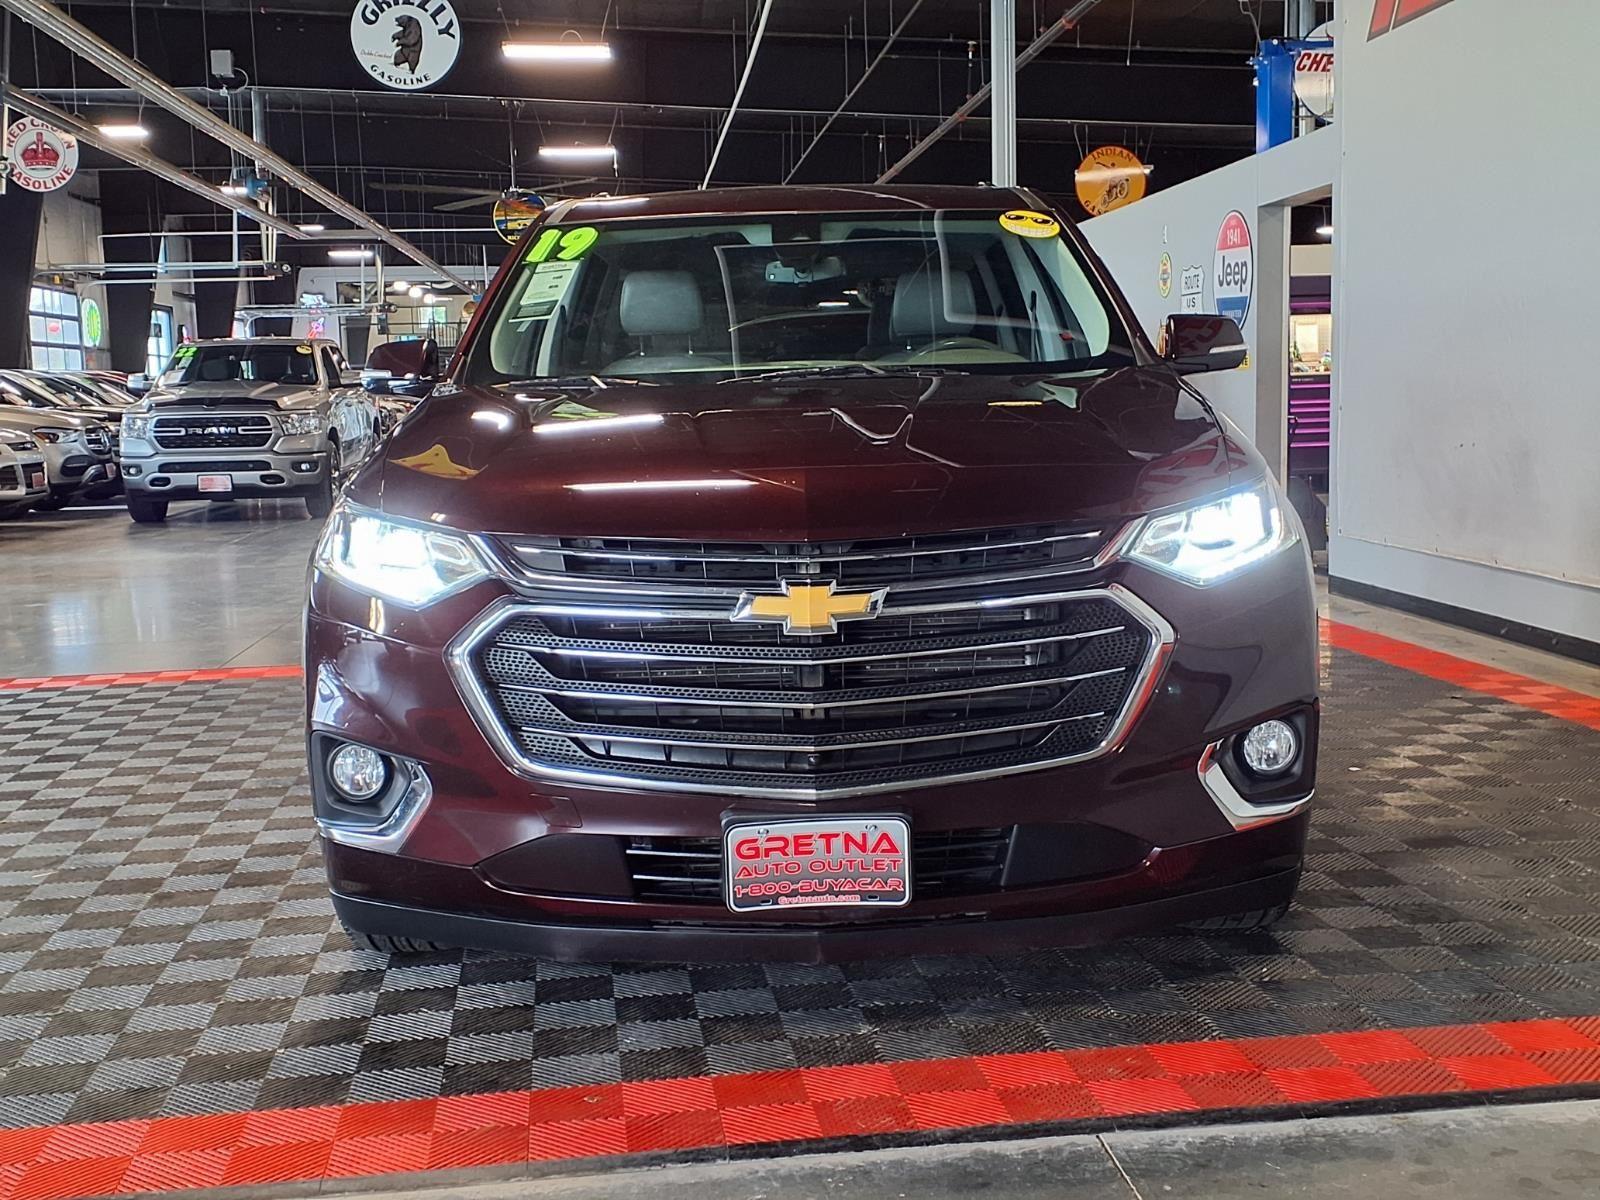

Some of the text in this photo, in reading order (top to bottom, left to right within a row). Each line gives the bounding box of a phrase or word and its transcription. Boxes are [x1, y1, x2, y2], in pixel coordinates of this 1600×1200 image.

[361, 0, 456, 40] GRZLY
[370, 64, 432, 86] GASOLINE
[6, 118, 76, 150] RED CRN
[1091, 148, 1134, 162] INDIAN
[9, 162, 74, 190] GASOLINE
[525, 227, 599, 262] 19
[1226, 227, 1241, 246] 1941
[1184, 273, 1200, 290] ROUTE
[1217, 255, 1248, 293] Jeep
[1186, 297, 1196, 308] US
[187, 426, 237, 435] RAM
[734, 831, 902, 861] GRETNA
[734, 857, 903, 879] AUTO OUTLET
[734, 878, 904, 898] 1-800-BUYACAR
